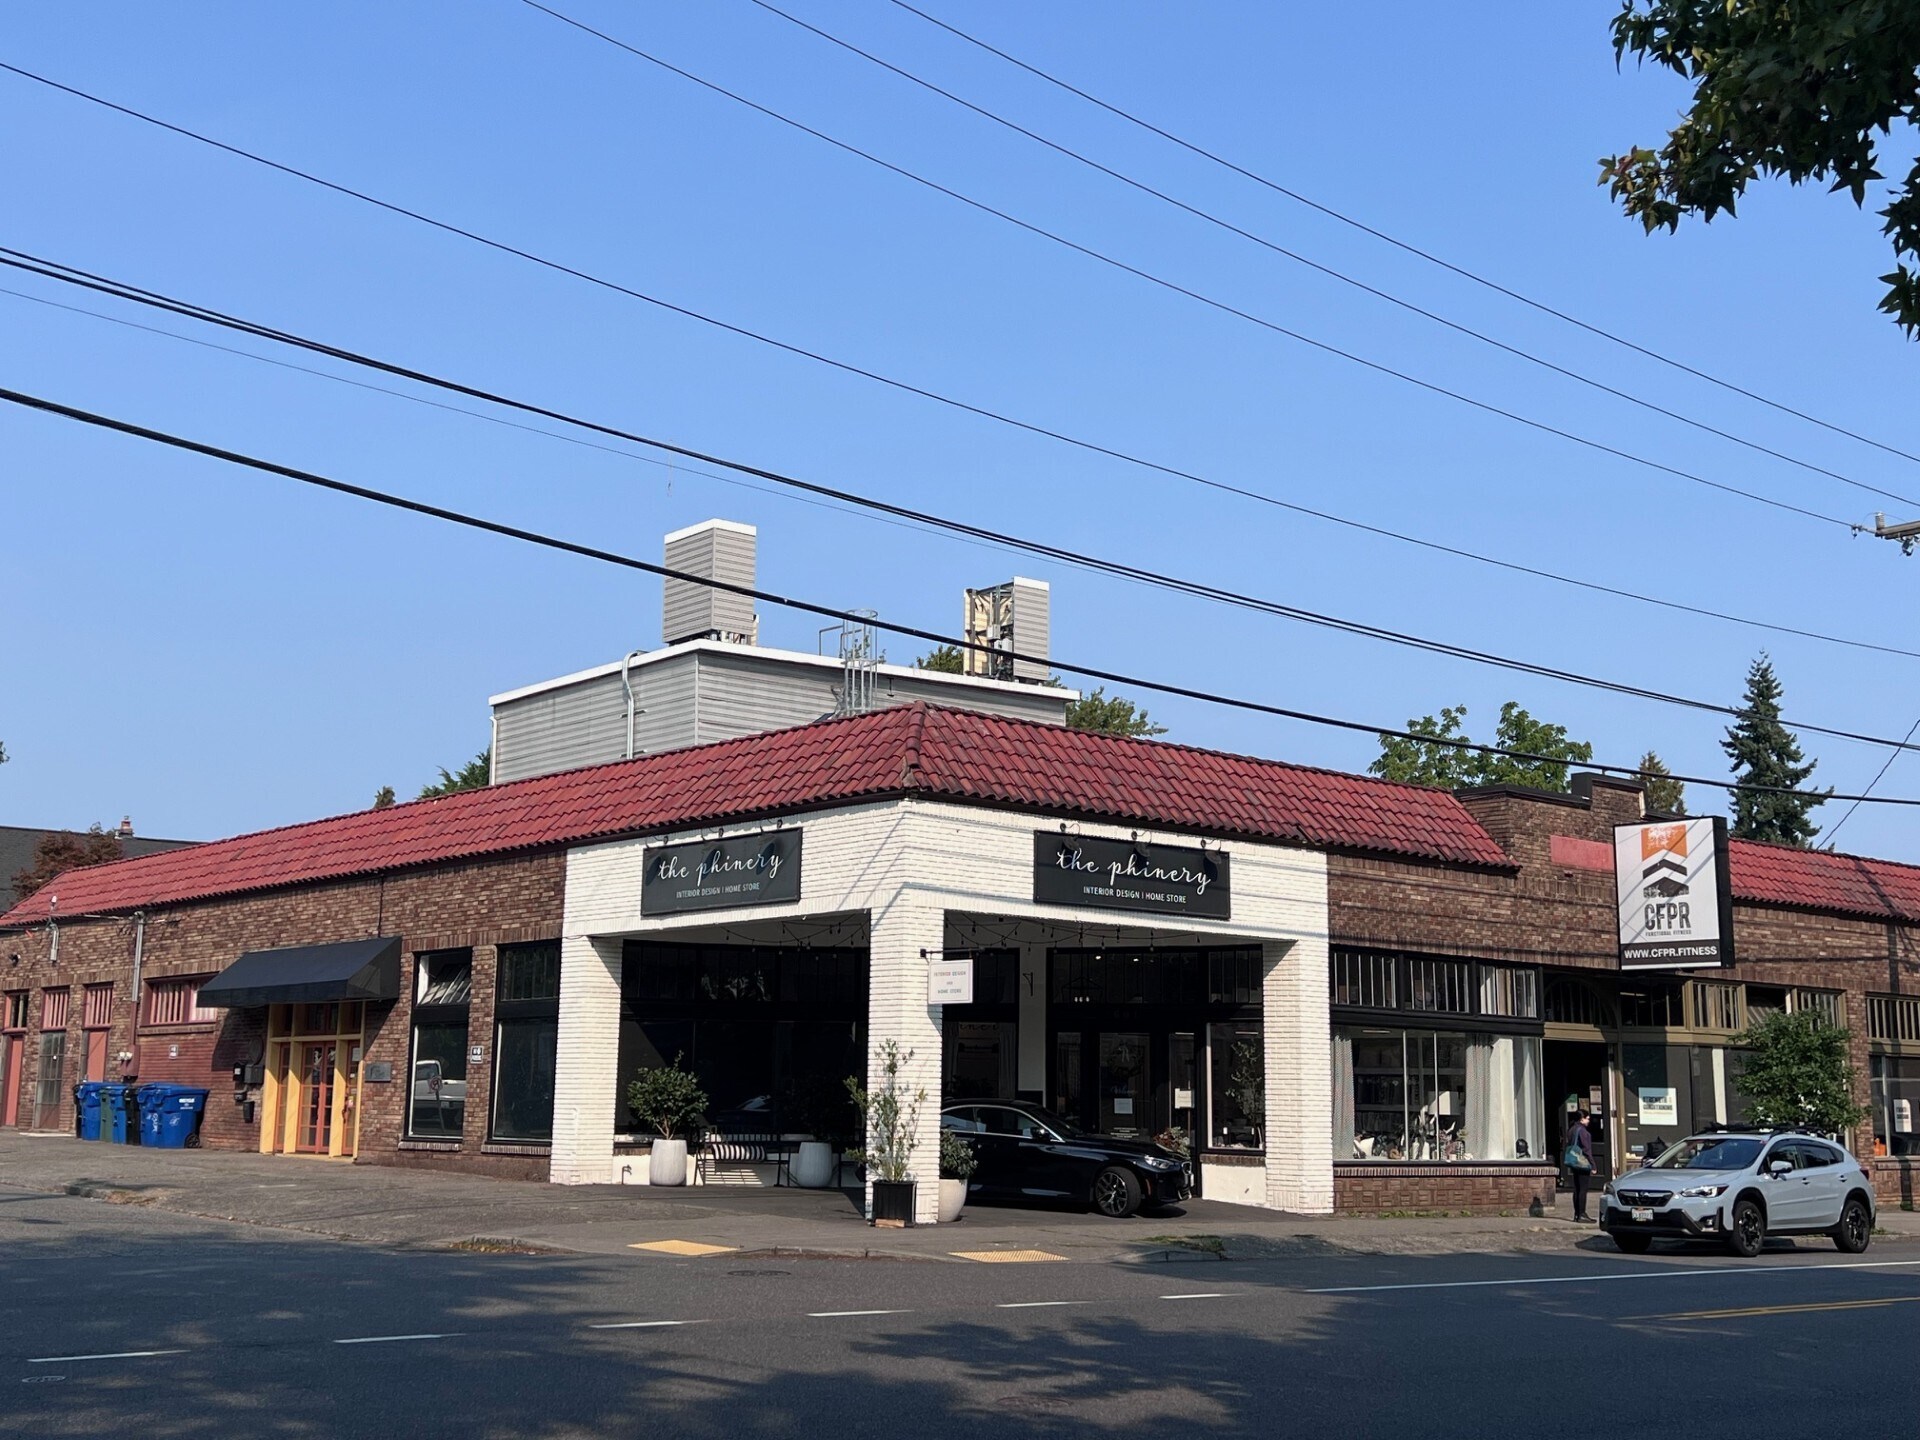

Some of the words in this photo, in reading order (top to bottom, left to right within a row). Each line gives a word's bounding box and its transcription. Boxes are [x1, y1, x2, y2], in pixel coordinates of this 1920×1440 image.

[658, 855, 690, 880] the
[695, 850, 784, 887] phinery
[1056, 848, 1099, 873] the
[1107, 854, 1211, 895] phinery
[676, 888, 701, 899] INTERIOR
[701, 886, 721, 896] DESIGN
[724, 884, 741, 893] HOME
[742, 882, 761, 892] STORE
[1083, 886, 1114, 897] INTERIOR
[1116, 889, 1140, 899] DESIGN
[1145, 892, 1165, 902] HOME
[1166, 894, 1187, 904] STORE
[1644, 901, 1691, 930] CFPR
[1624, 945, 1718, 959] WWW.CFPR.FITNESS
